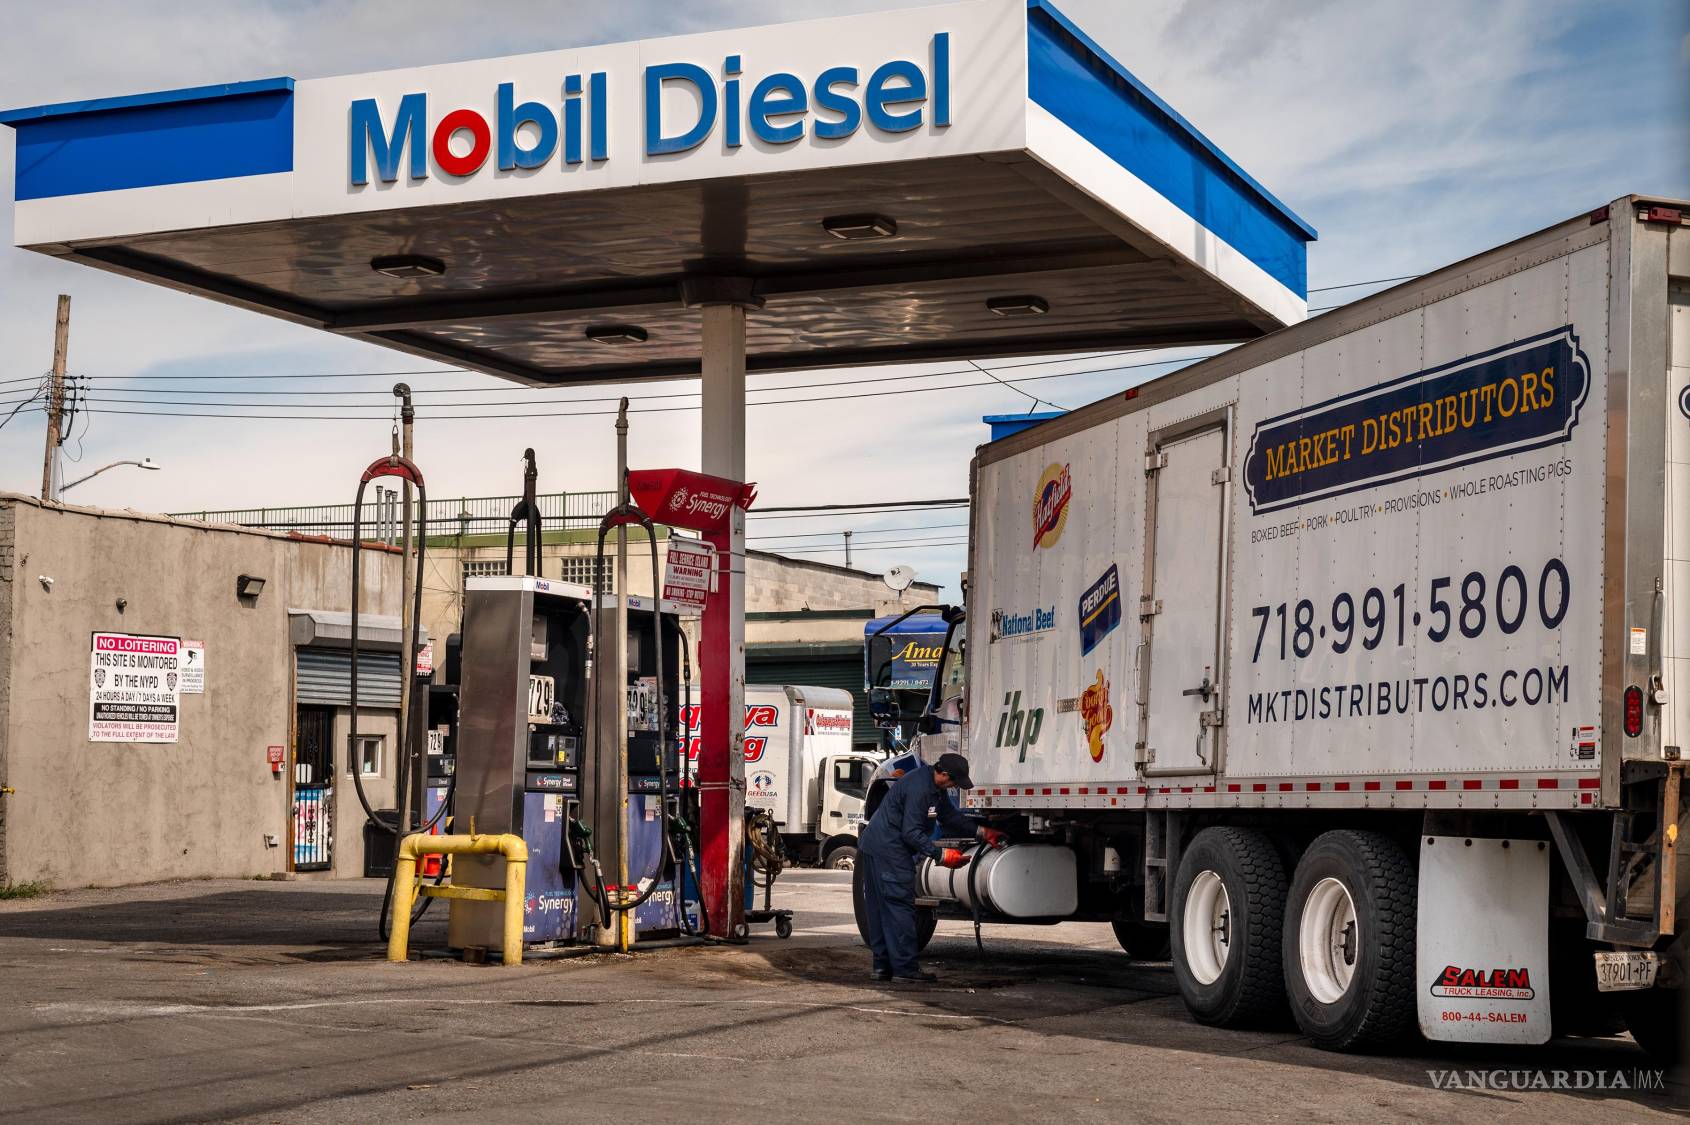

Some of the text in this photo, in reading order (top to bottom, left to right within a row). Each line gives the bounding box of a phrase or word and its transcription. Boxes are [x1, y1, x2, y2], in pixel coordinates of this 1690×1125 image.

[349, 32, 951, 187] Mobil Diesel
[1265, 367, 1555, 481] MARKET DISTRIBUTORS
[686, 493, 729, 519] Synergy
[1251, 459, 1572, 544] BOXED BEEF PORK POULTRY PROVISIONS WHOLE ROASTING PIGS
[673, 566, 703, 578] WARNING
[536, 580, 549, 591] Mobil
[1082, 571, 1117, 617] PERDUE
[629, 598, 641, 608] Mobil
[1002, 605, 1054, 637] National Beef
[99, 638, 115, 649] NO
[118, 640, 175, 653] LOITERING
[96, 653, 111, 666] THIS
[112, 654, 128, 667] SITE
[129, 655, 136, 668] IS
[137, 655, 178, 670] MONITORED
[114, 674, 159, 688] BY THE NYPD
[103, 691, 120, 701] HOURS
[161, 694, 175, 703] WEEK
[1247, 665, 1569, 724] MKTDISTRIBUTORS.COM
[995, 690, 1045, 763] ibp
[538, 895, 574, 914] Synergy
[1442, 966, 1530, 988] SALEM
[1600, 963, 1631, 981] 37901
[1443, 987, 1532, 998] TRUCK LEASING, inc.
[1442, 1011, 1527, 1023] 800-44-SALEM
